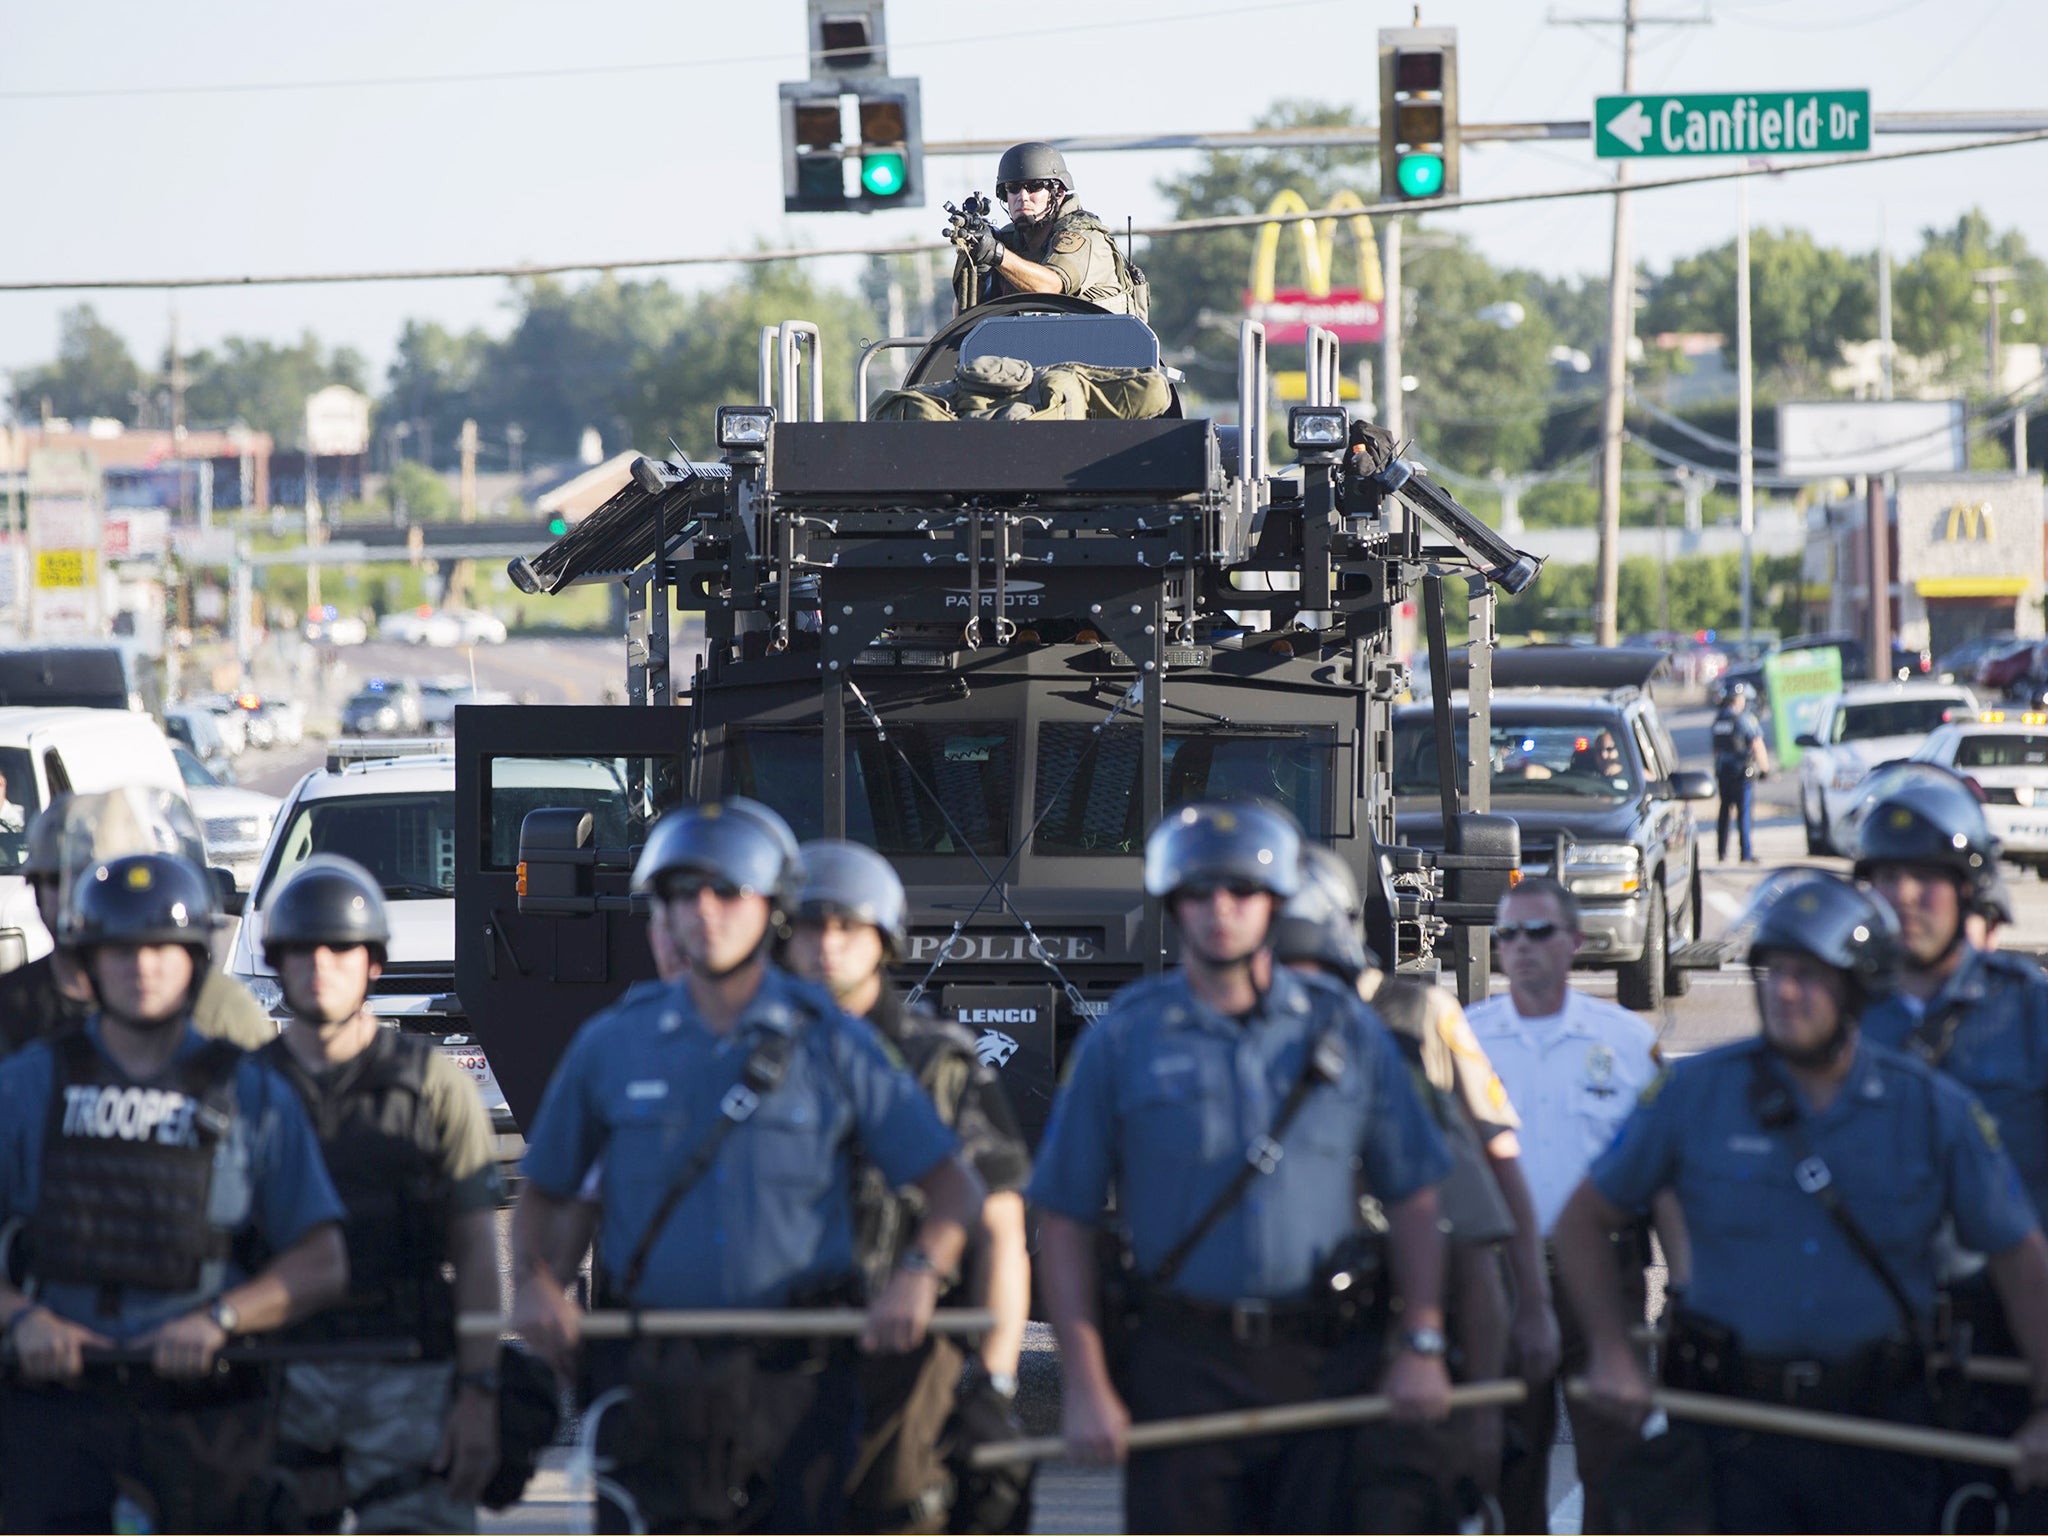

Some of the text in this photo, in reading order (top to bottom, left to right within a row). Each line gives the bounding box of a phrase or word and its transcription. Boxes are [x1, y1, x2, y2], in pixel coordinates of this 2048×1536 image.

[1660, 97, 1860, 152] Canfield Dr
[945, 594, 1039, 607] PAROT3
[908, 936, 1095, 961] POLICE
[958, 1009, 1037, 1024] LENCO
